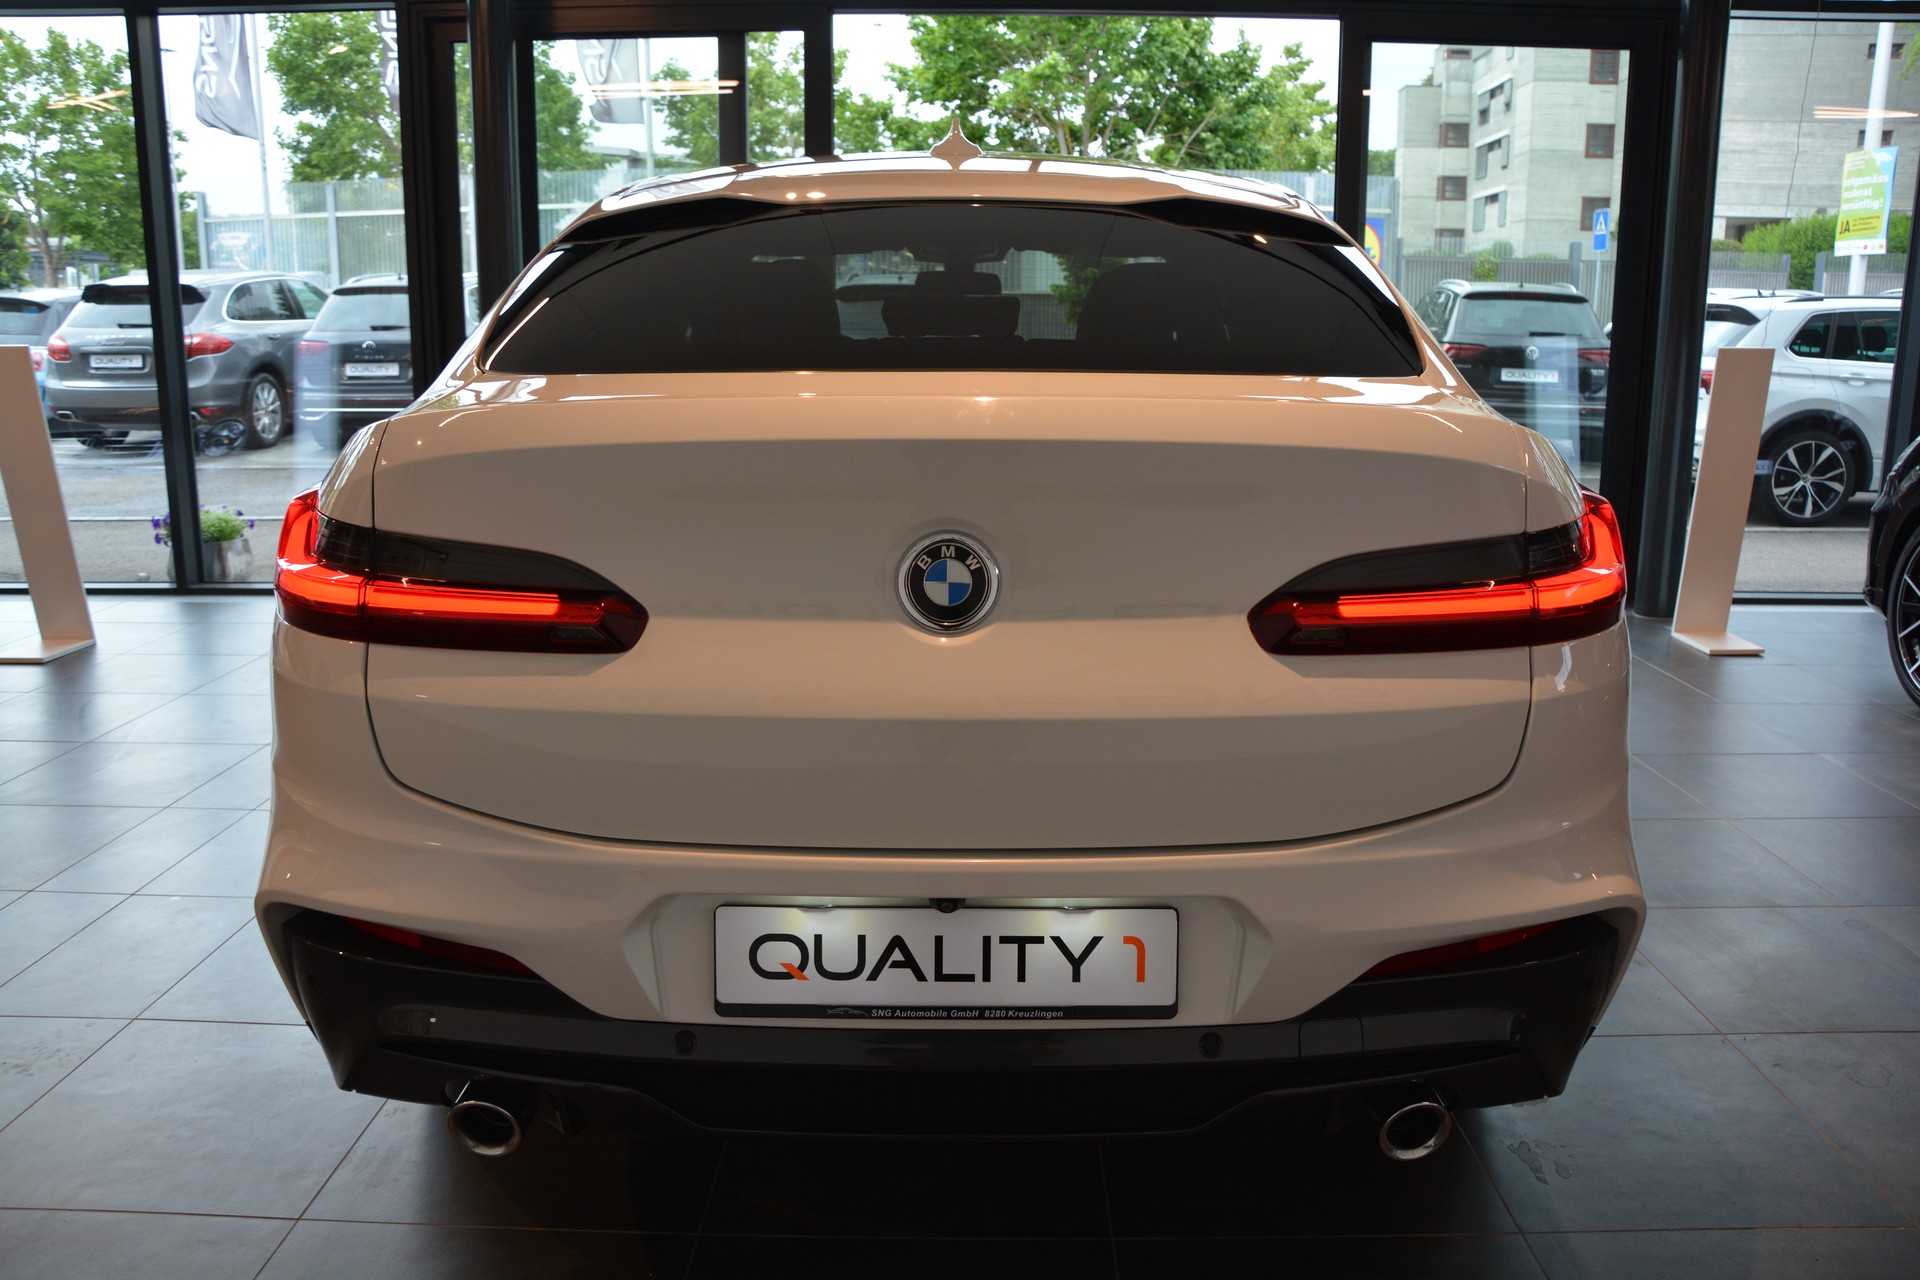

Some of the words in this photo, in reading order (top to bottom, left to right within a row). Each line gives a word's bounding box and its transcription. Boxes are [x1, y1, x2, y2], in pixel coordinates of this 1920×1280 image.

[1839, 220, 1851, 235] JA
[1505, 371, 1549, 379] QUALITY
[916, 545, 982, 571] BMW
[748, 933, 1105, 983] QUALITY
[1122, 935, 1146, 983] 1
[871, 1009, 892, 1017] SNG
[894, 1009, 948, 1018] Automobile
[950, 1009, 979, 1018] GmbH
[984, 1009, 1007, 1018] 8280
[1007, 1009, 1064, 1020] Kreuzlingen
